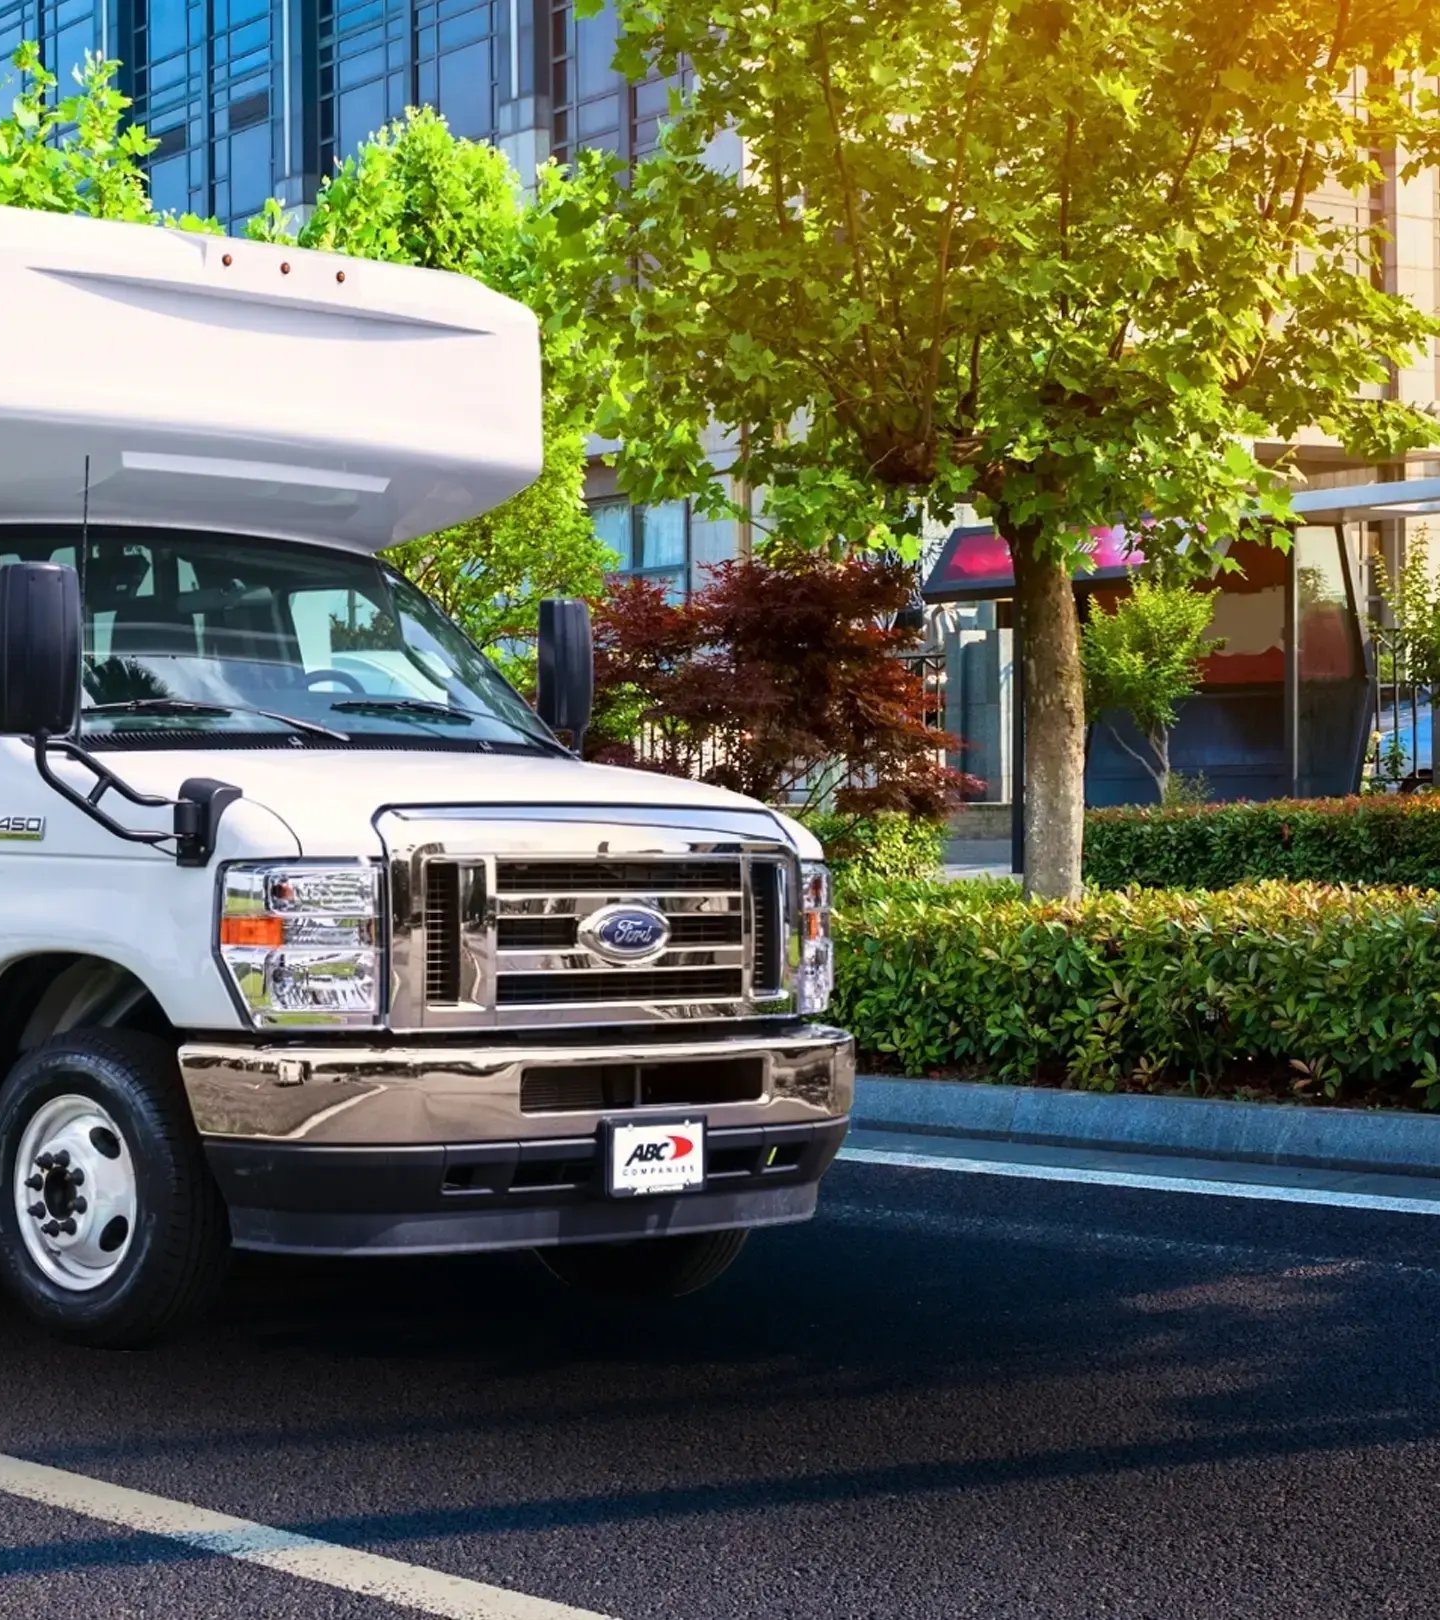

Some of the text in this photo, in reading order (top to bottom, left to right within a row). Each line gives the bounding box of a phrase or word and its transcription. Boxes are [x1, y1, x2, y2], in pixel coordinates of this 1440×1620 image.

[614, 919, 653, 943] Ford
[624, 1142, 670, 1167] ABC
[622, 1165, 694, 1176] COMPANIES
